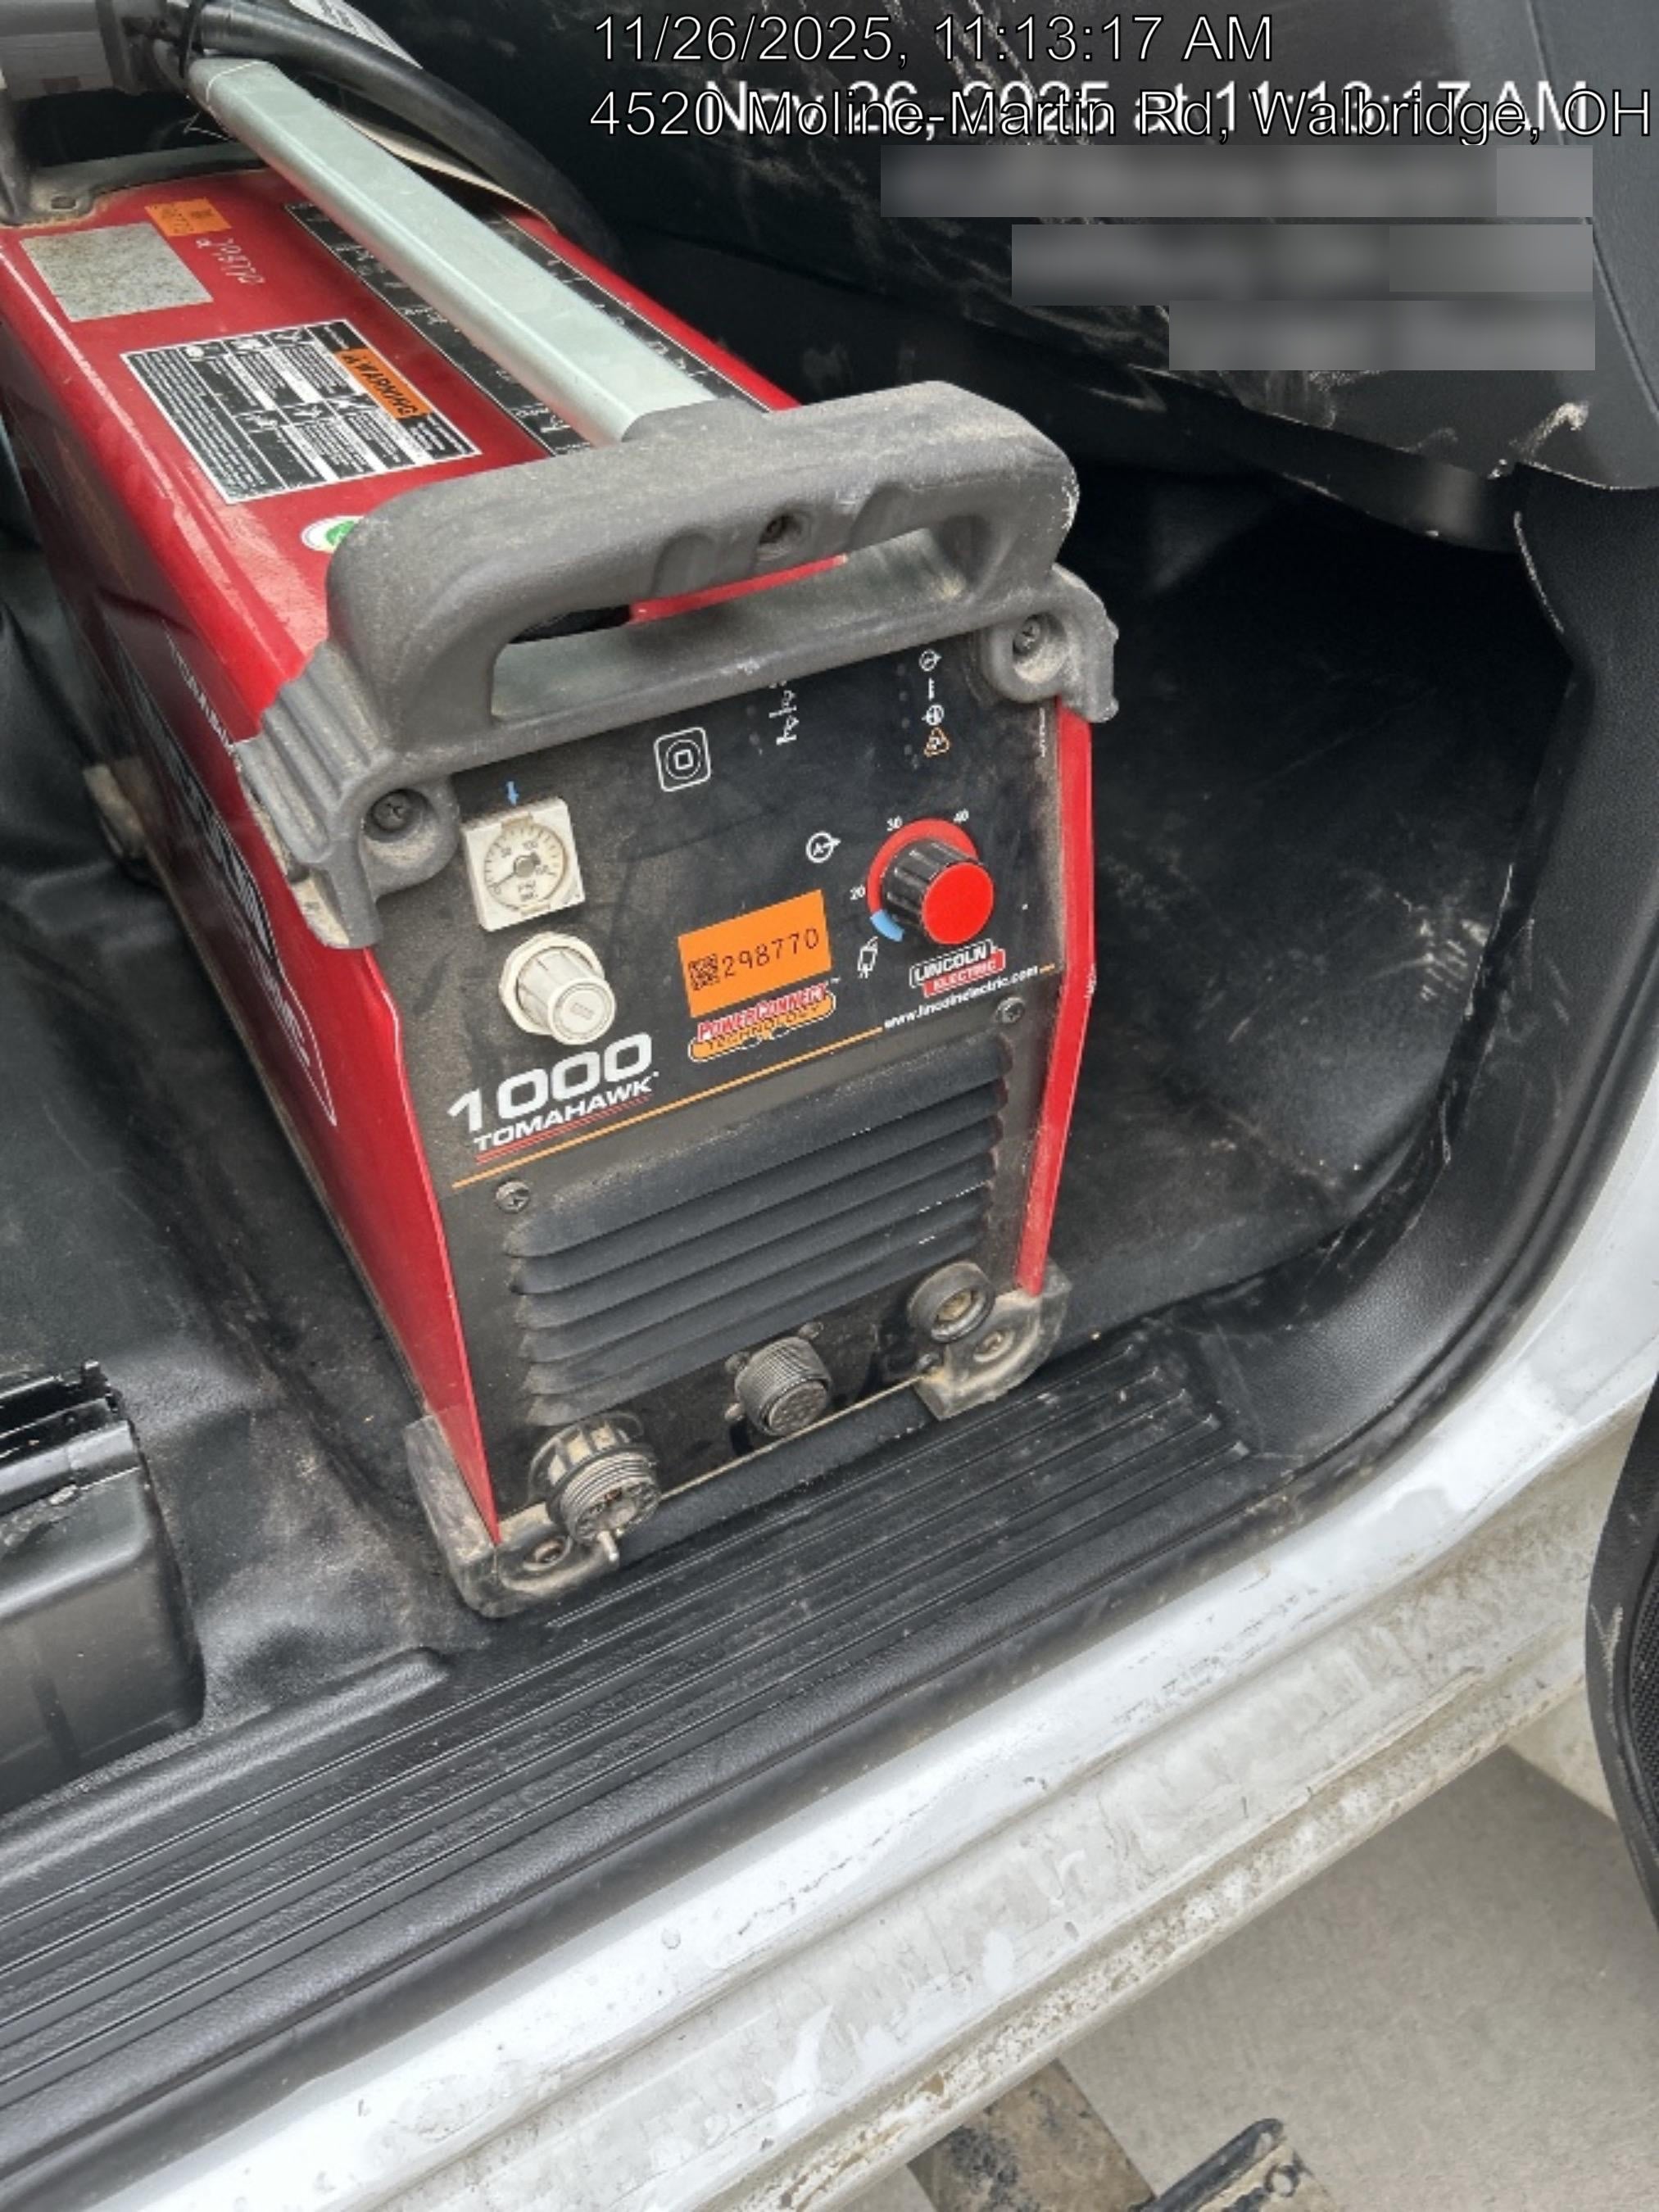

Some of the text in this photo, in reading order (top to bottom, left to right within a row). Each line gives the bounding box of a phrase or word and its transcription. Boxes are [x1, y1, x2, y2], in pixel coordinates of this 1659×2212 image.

[850, 885, 866, 900] 20
[721, 927, 819, 979] 298770
[913, 941, 988, 982] LINCOLN
[931, 959, 998, 991] ELECTRIC
[884, 965, 1039, 1029] www.lincolnelectric.com
[447, 1031, 652, 1133] 1000
[473, 1075, 654, 1151] TOMAHAWK
